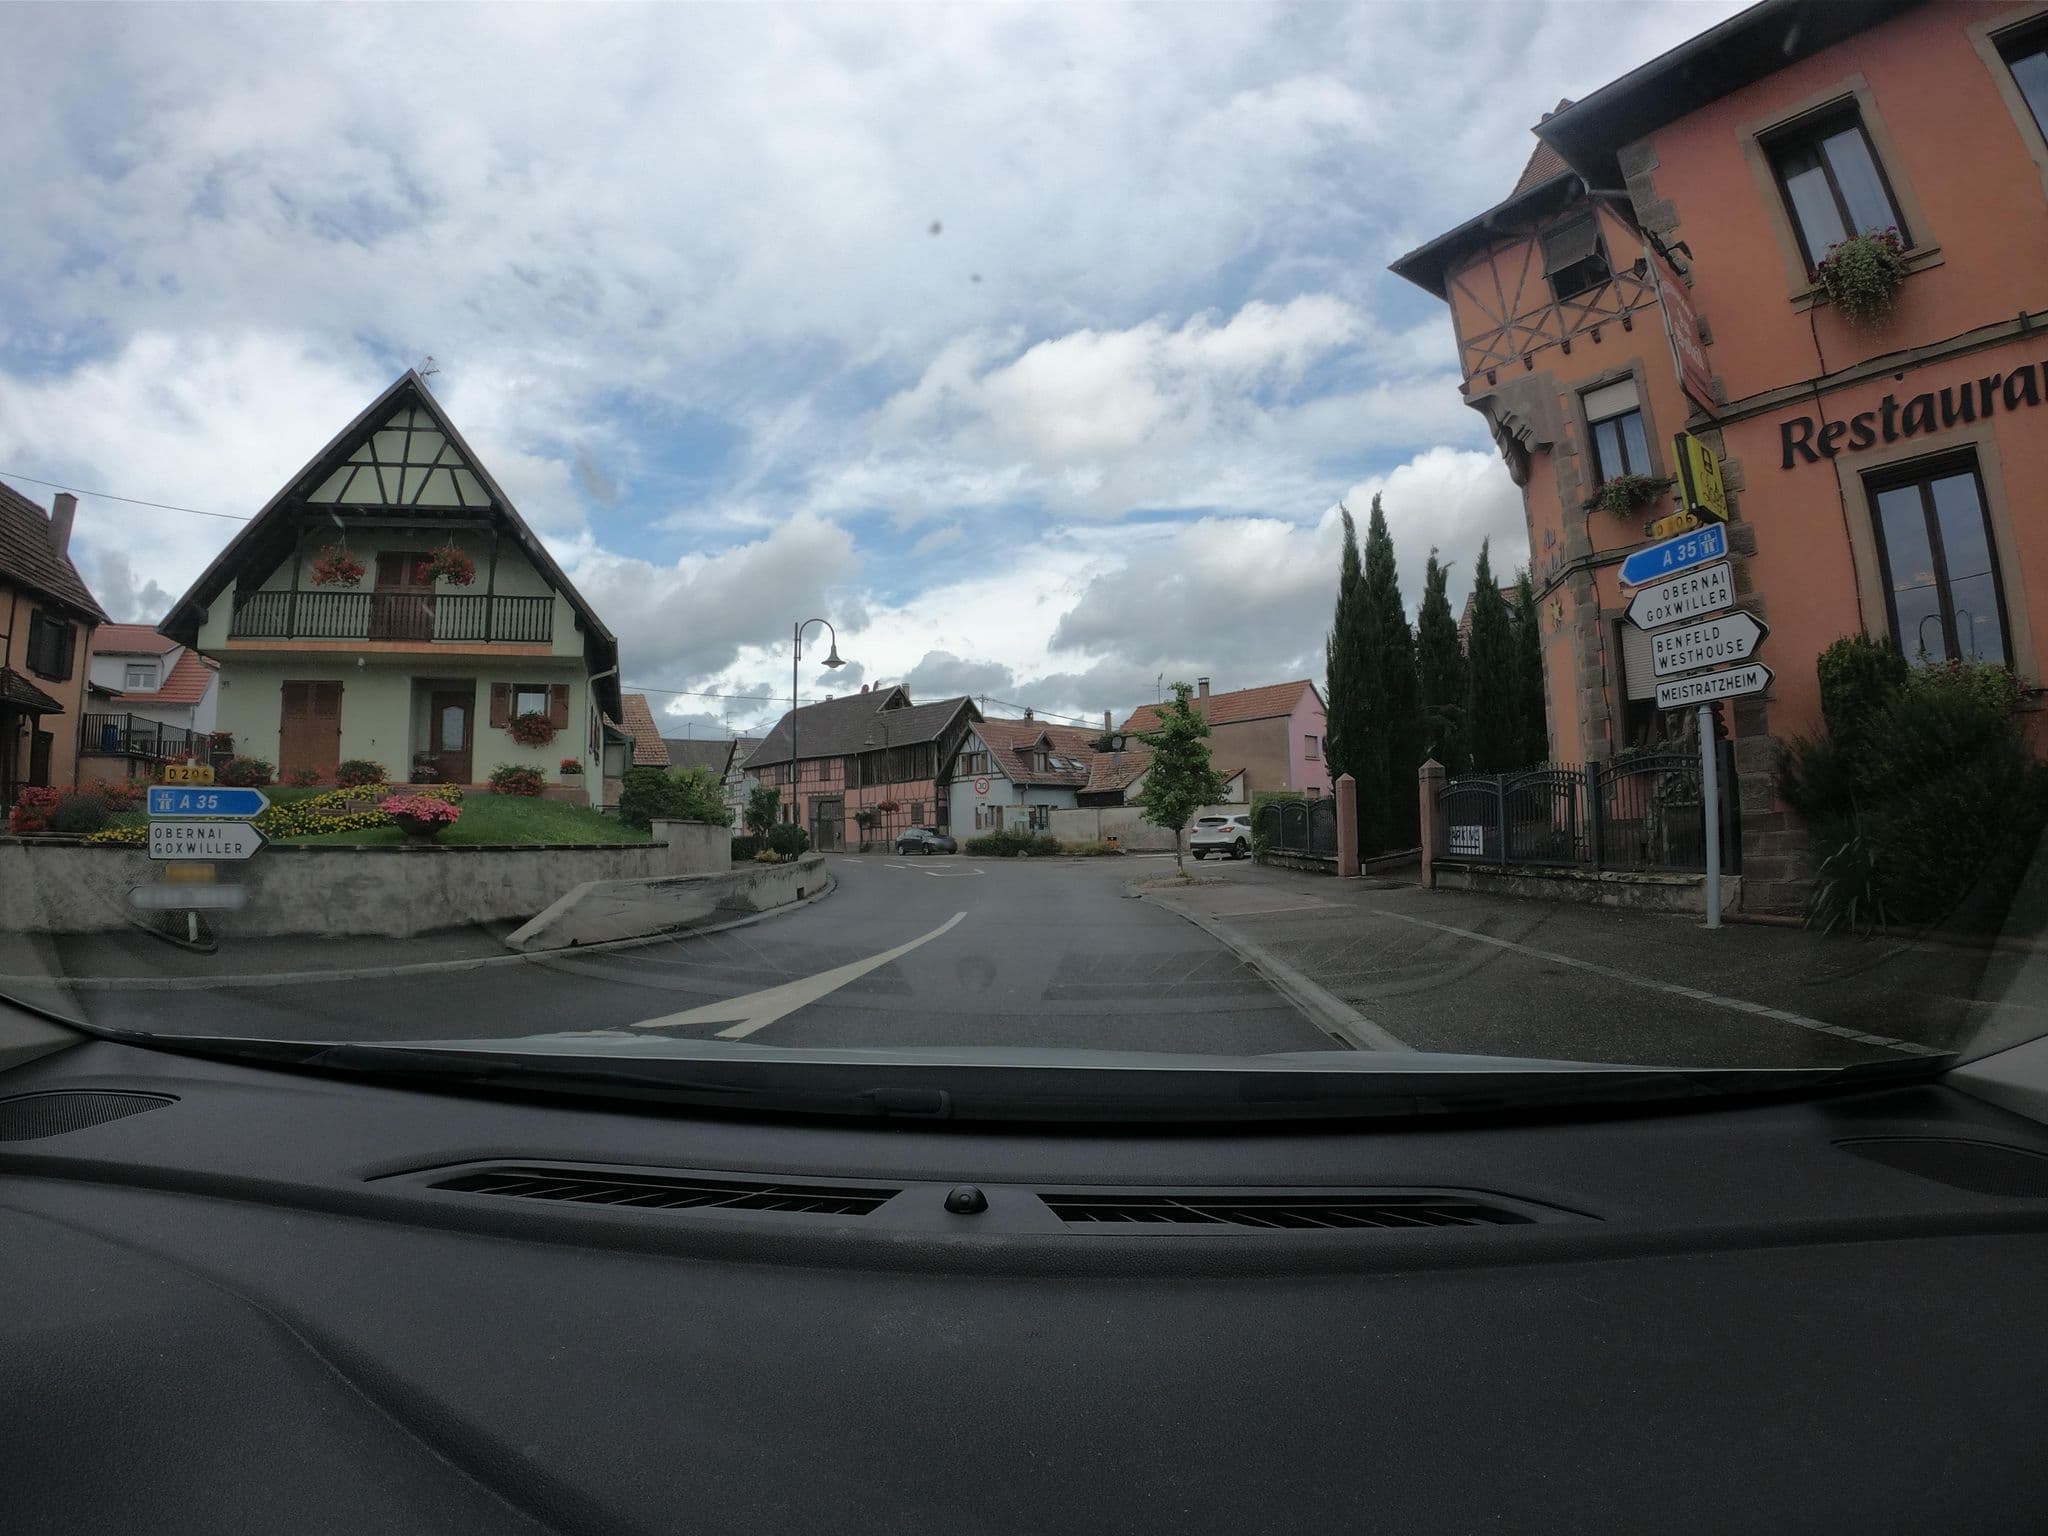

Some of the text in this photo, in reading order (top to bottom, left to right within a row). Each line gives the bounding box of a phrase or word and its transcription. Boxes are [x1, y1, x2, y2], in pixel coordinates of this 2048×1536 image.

[1779, 361, 2048, 470] Restaura
[1663, 540, 1697, 568] A 35
[1662, 571, 1726, 601] OBERNAI
[1646, 588, 1728, 622] GOXWILLER
[1656, 626, 1720, 653] BENFELD
[1658, 638, 1745, 669] WESTHOUSE
[1661, 672, 1758, 702] MEISTRATZHEIM
[169, 769, 177, 780] D
[179, 794, 219, 809] A 35
[154, 827, 223, 840] OBERNAI
[154, 842, 242, 854] GOXWILLER
